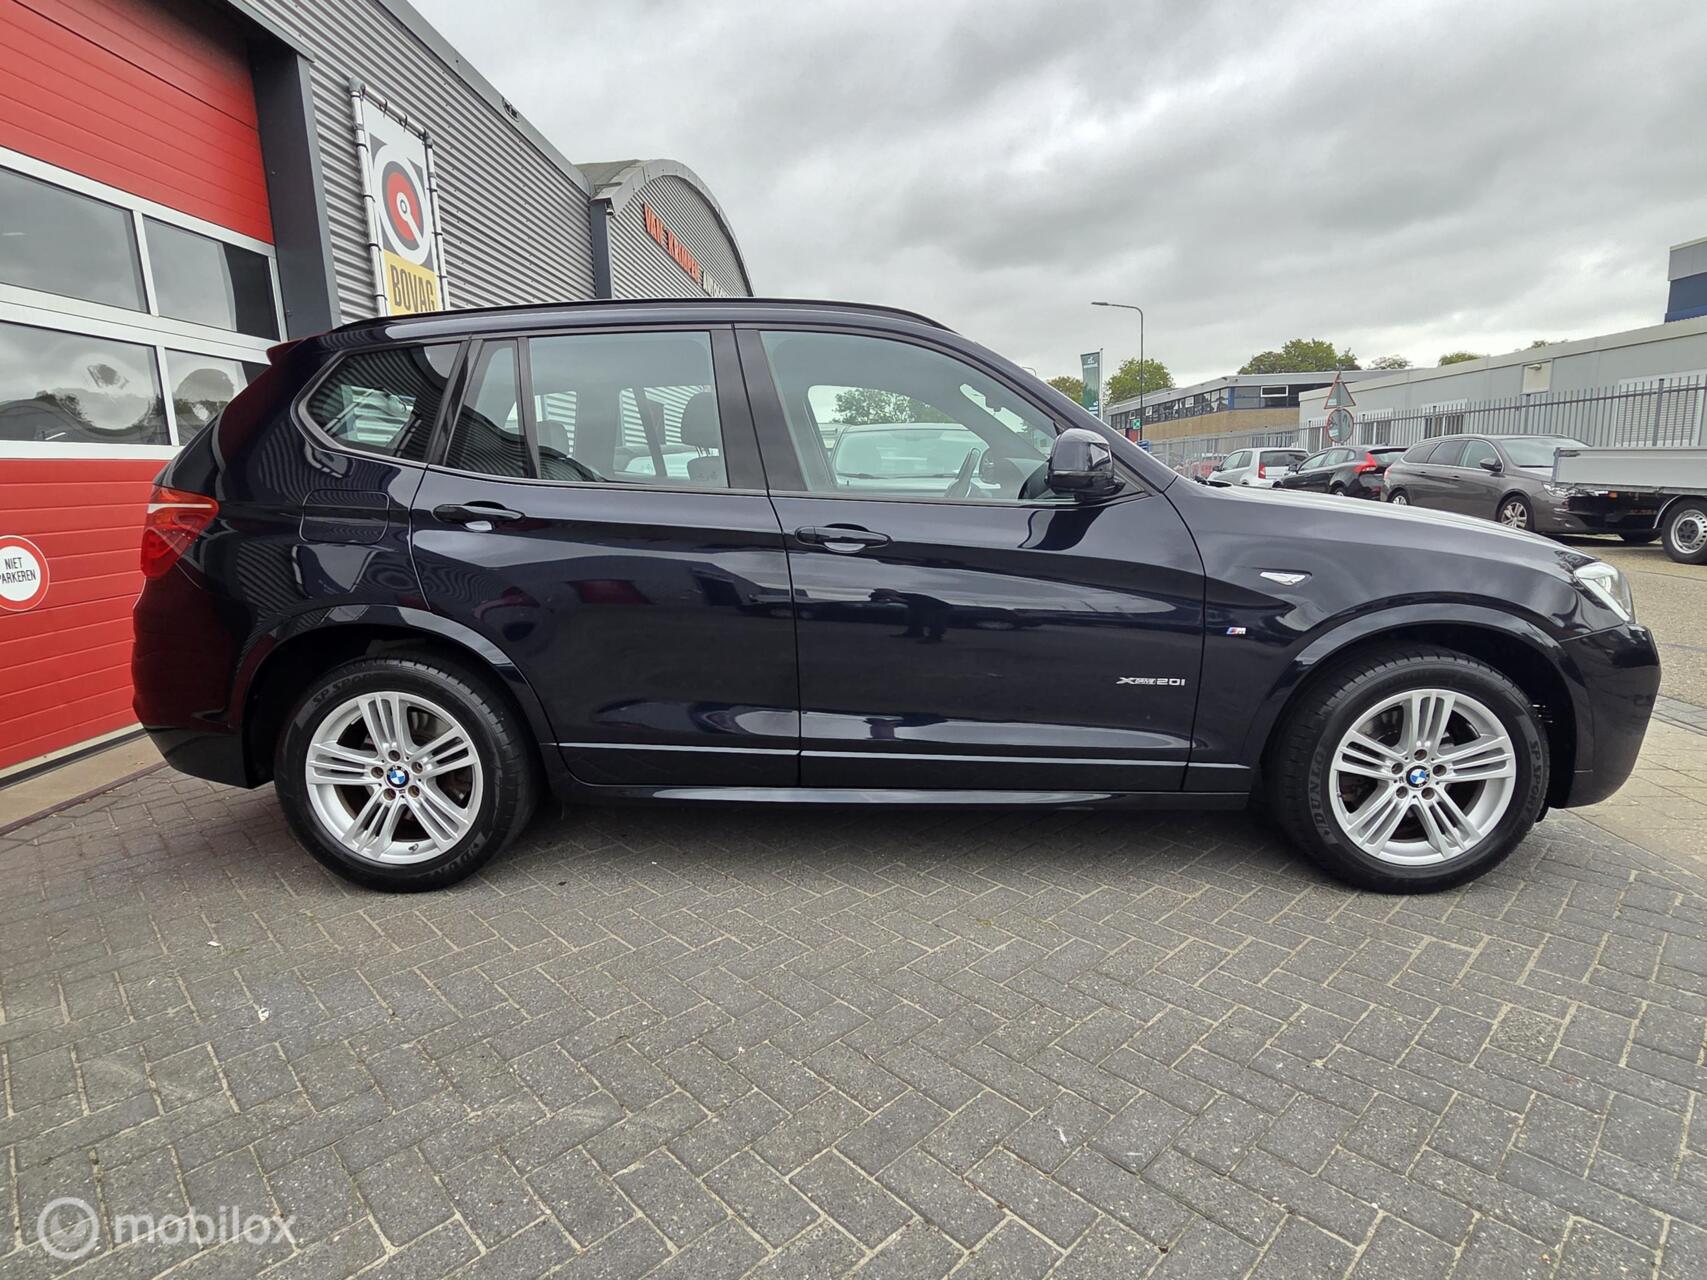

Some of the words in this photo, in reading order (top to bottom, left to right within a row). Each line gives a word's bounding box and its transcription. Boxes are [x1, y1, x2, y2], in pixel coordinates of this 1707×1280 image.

[390, 263, 436, 312] BOVAG
[4, 557, 22, 570] NIET
[0, 569, 36, 584] ARKEREN
